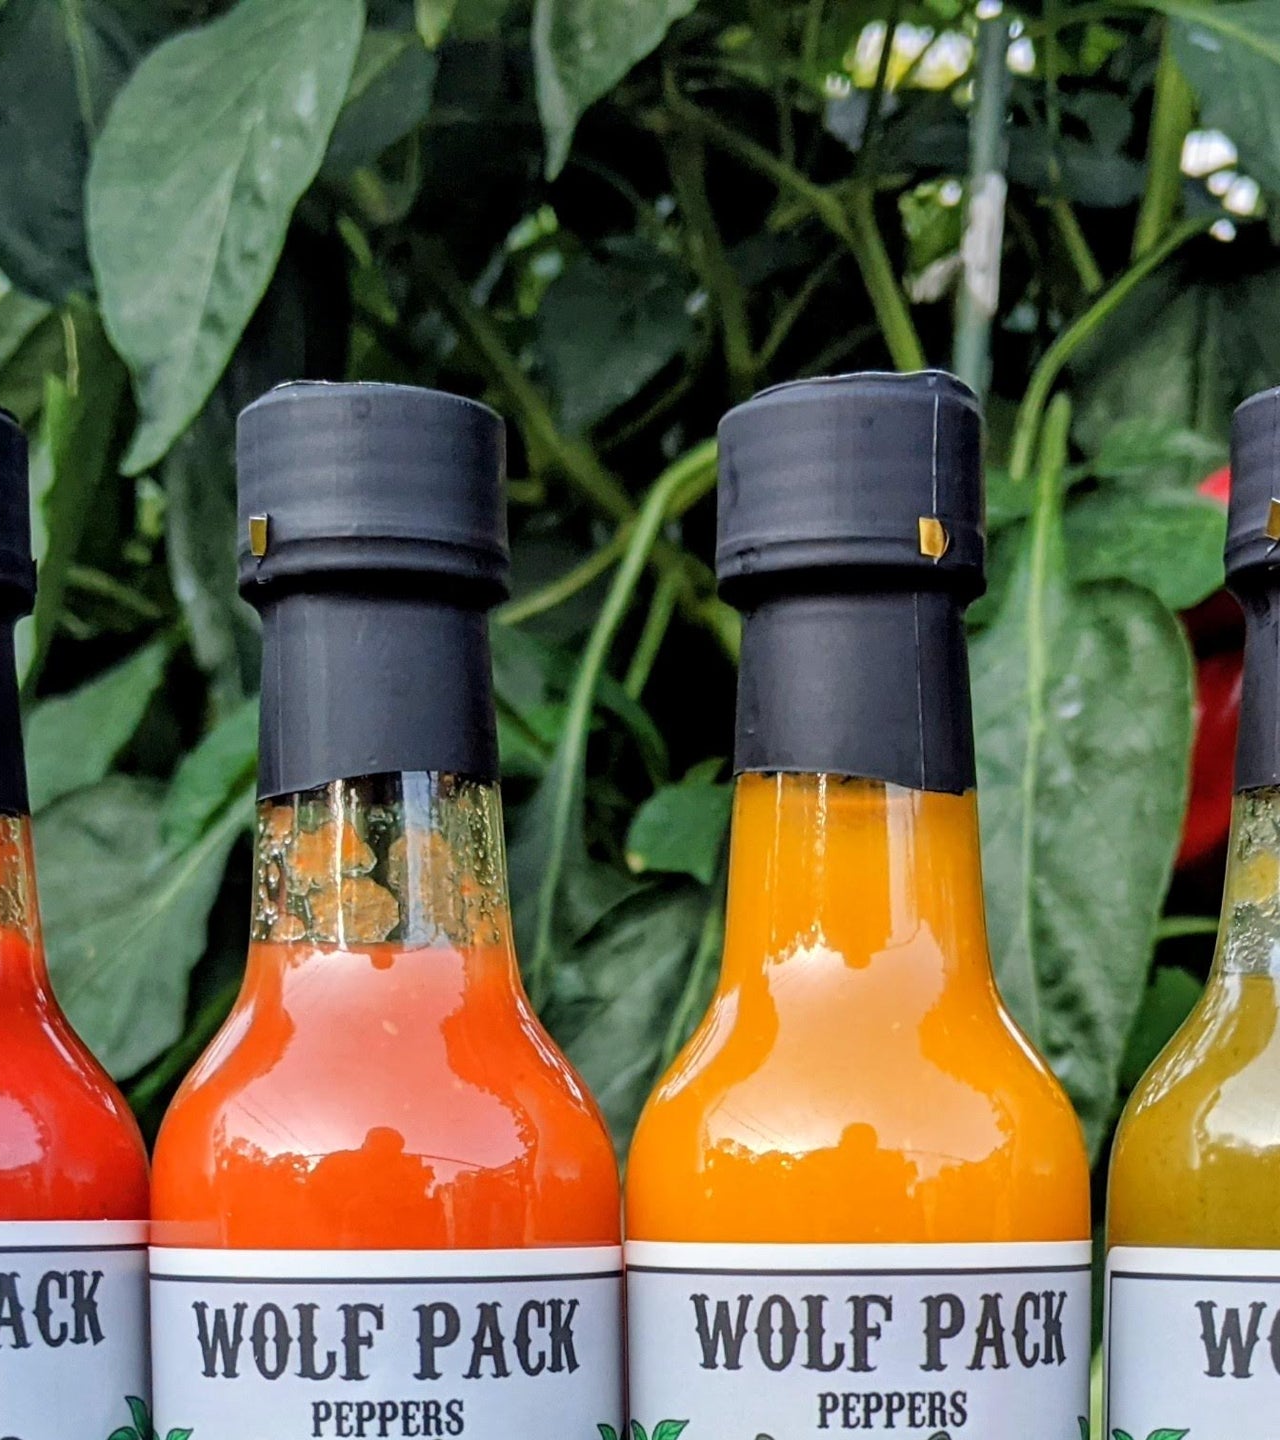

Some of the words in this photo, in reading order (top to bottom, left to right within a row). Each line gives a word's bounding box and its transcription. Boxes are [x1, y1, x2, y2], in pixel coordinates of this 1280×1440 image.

[192, 1302, 384, 1381] WOLF
[413, 1298, 580, 1380] PACK
[689, 1293, 893, 1372] WOLF
[920, 1290, 1068, 1371] PACK
[311, 1399, 464, 1438] PEPPERS
[817, 1390, 967, 1429] PEPPERS
